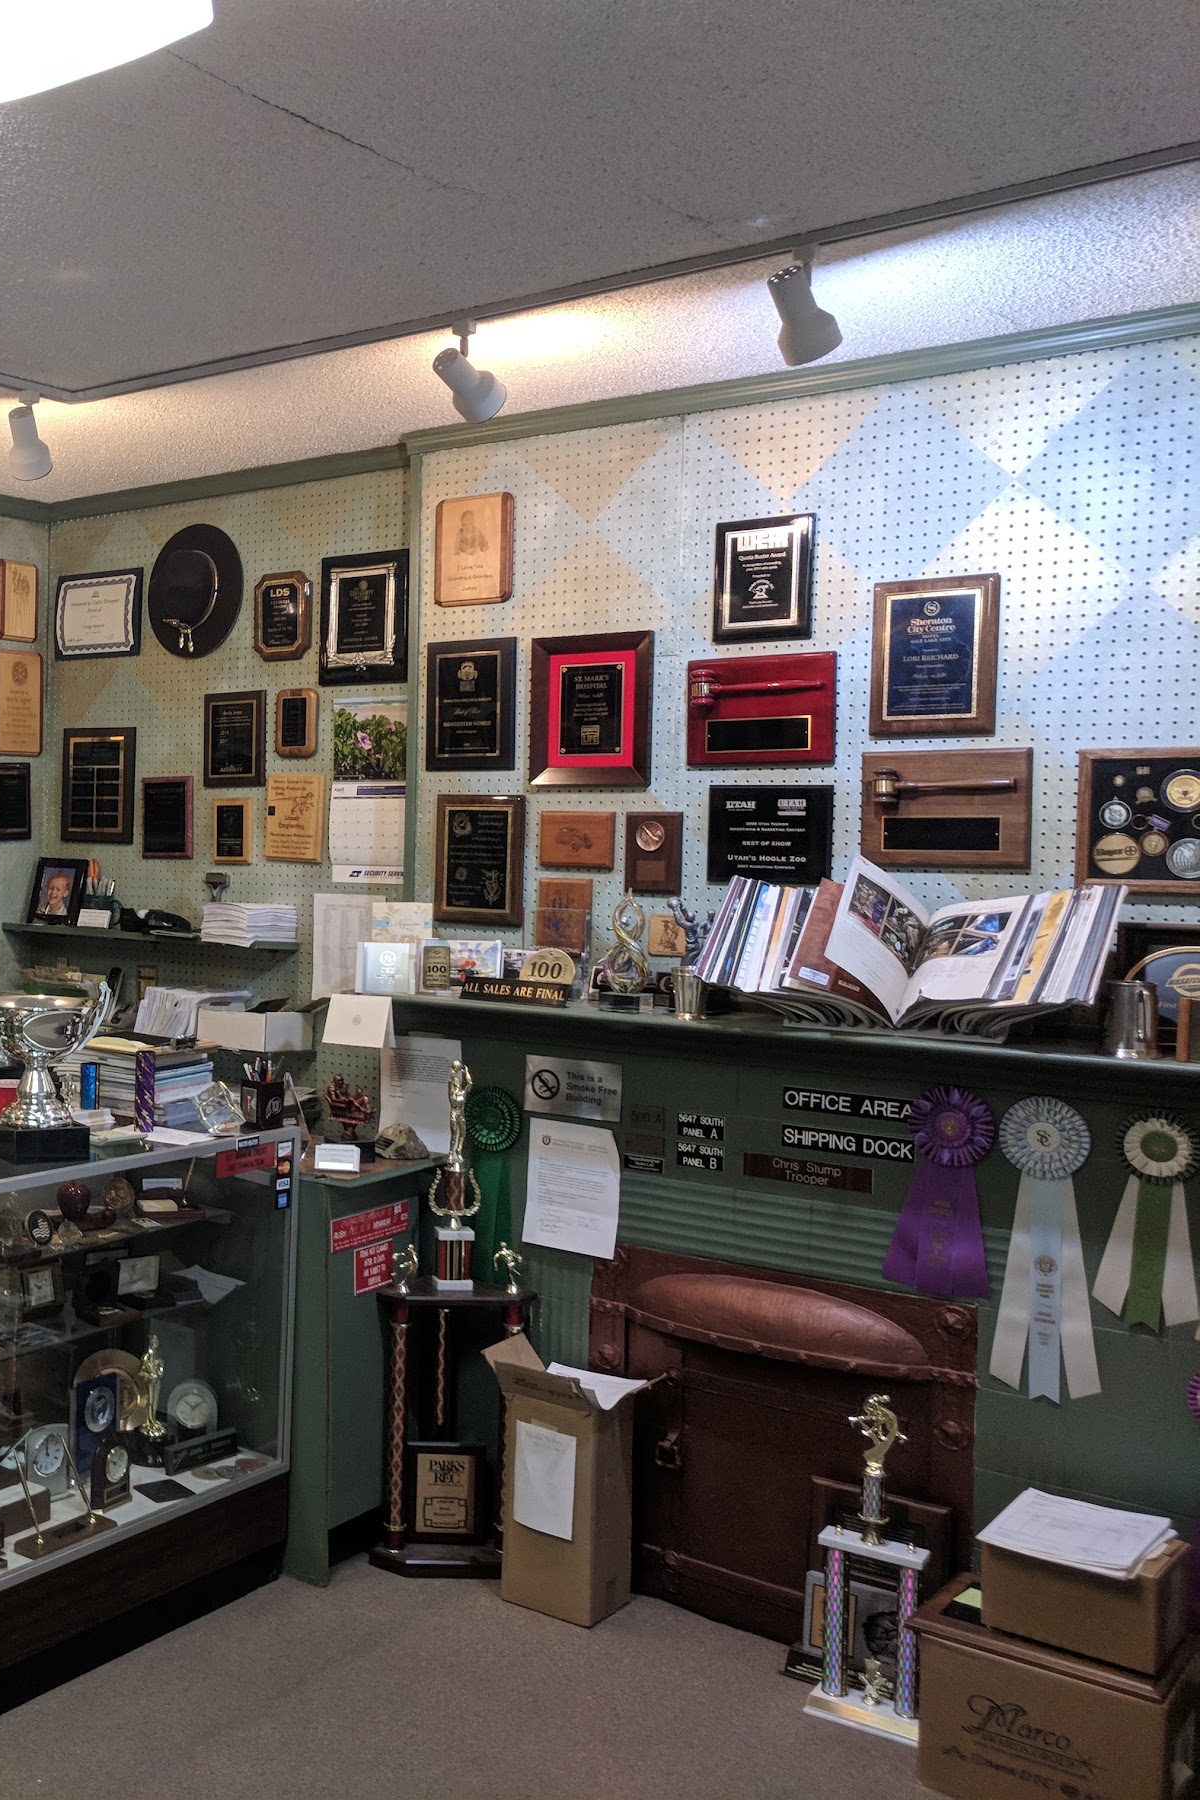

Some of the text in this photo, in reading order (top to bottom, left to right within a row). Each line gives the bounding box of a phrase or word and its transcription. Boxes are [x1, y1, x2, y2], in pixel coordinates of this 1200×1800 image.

[269, 587, 290, 597] LDS
[910, 617, 952, 626] Sheraton
[925, 623, 956, 632] Centre
[920, 653, 959, 661] REICHARD
[583, 674, 609, 682] MARK'S
[583, 733, 599, 743] LIFE
[725, 800, 756, 809] UTAH
[278, 821, 304, 829] Engraving
[427, 965, 446, 973] 100
[527, 961, 563, 979] 100
[463, 983, 565, 1001] ALL SALES ARE FINAL
[566, 1071, 584, 1080] This
[565, 1082, 618, 1096] Smoke Free
[565, 1092, 601, 1106] Building
[784, 1091, 912, 1118] OFFICE AREA
[678, 1113, 723, 1126] 5647 SOUTH
[682, 1127, 718, 1139] PANEL A
[677, 1142, 722, 1156] 5647 SOUTH
[783, 1128, 913, 1159] SHIPPING DOCK
[682, 1156, 717, 1169] PANEL B
[772, 1157, 841, 1176] Chris Stump
[277, 1179, 289, 1187] VISA
[784, 1169, 828, 1185] Trooper
[428, 1459, 464, 1472] PARKS
[433, 1471, 460, 1483] REC
[962, 1694, 1071, 1750] Marco
